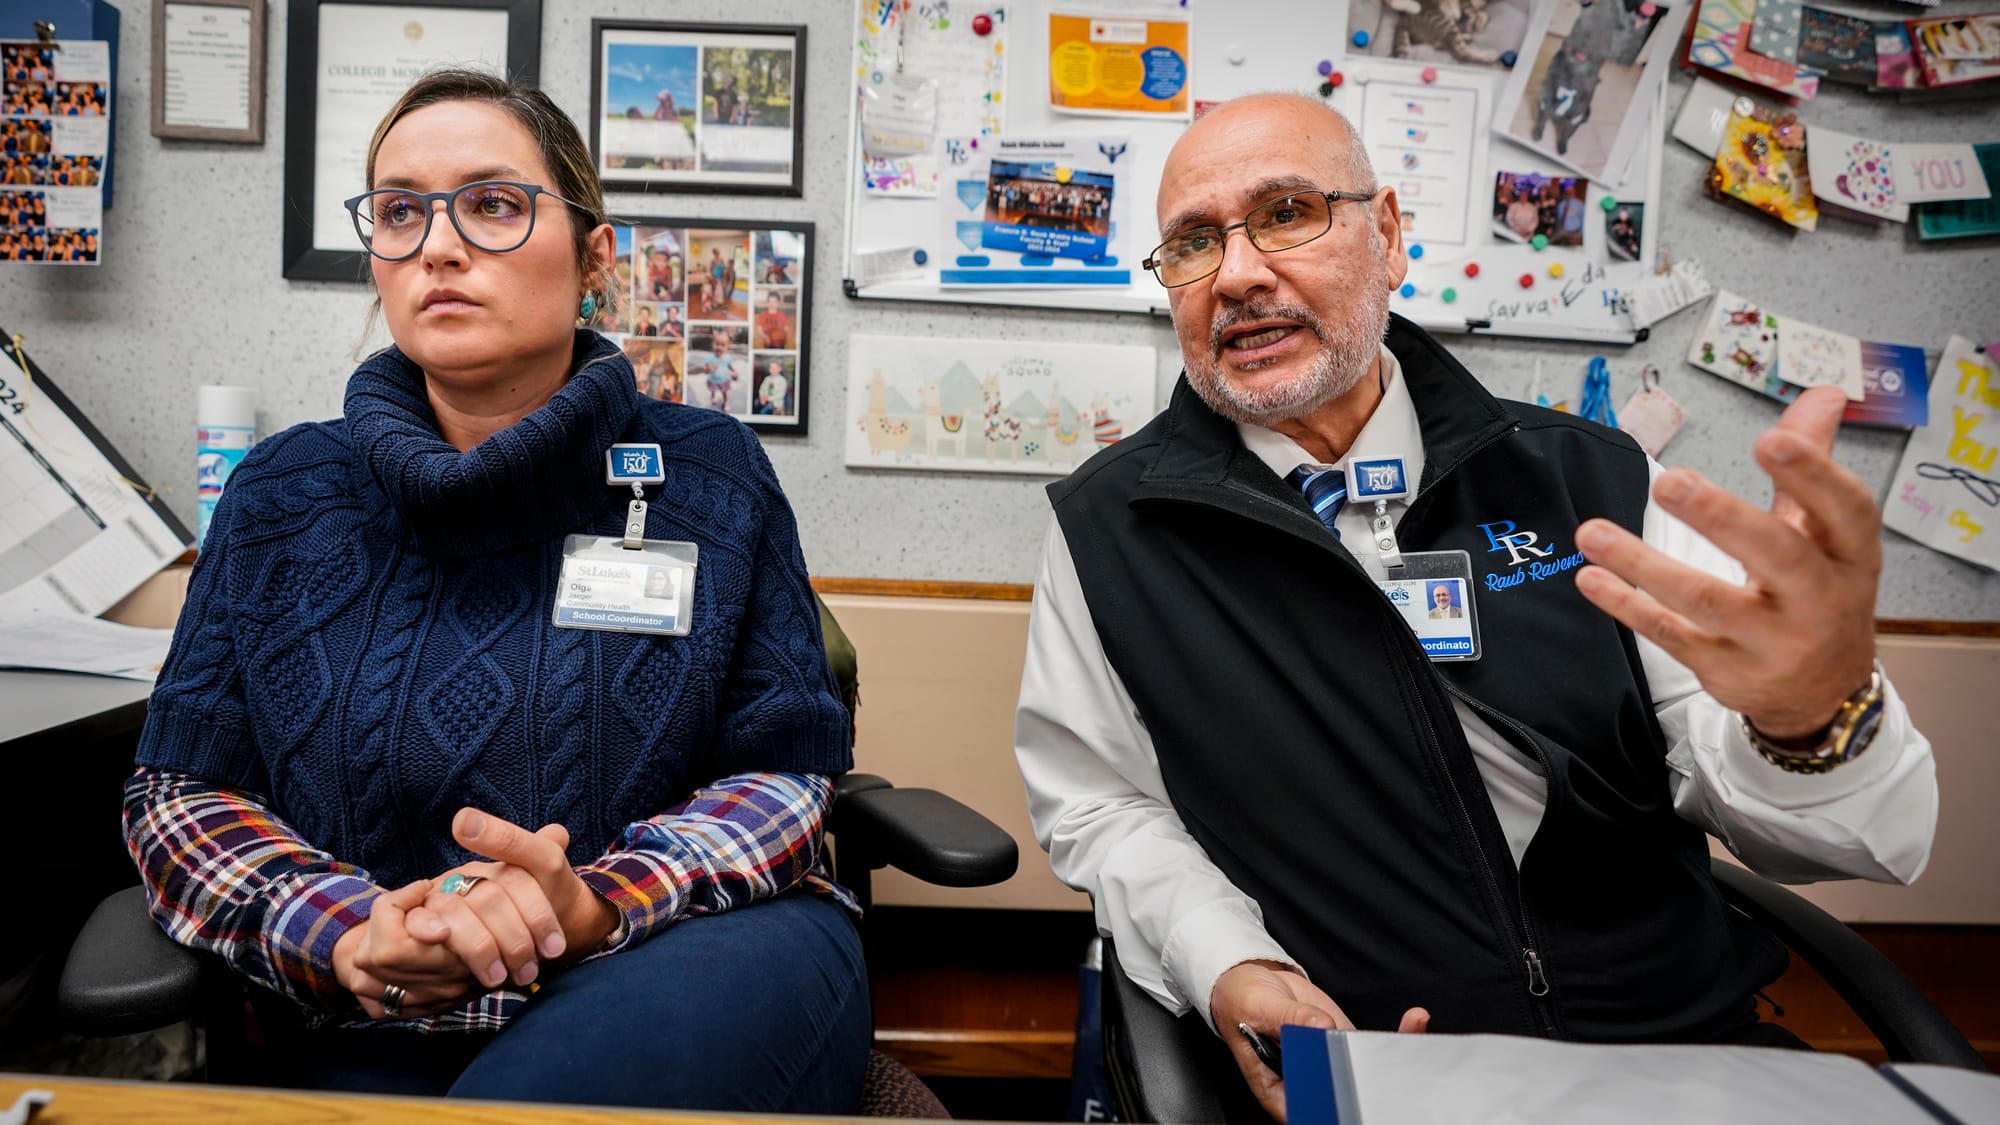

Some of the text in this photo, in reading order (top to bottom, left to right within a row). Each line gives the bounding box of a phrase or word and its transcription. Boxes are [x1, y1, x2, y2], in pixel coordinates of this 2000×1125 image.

[1043, 140, 1065, 148] School
[1911, 159, 1967, 192] YOU
[1485, 551, 1584, 592] Raub Ravens
[570, 583, 592, 593] Olga
[566, 600, 631, 611] Community Health
[572, 611, 664, 626] School Coordinator
